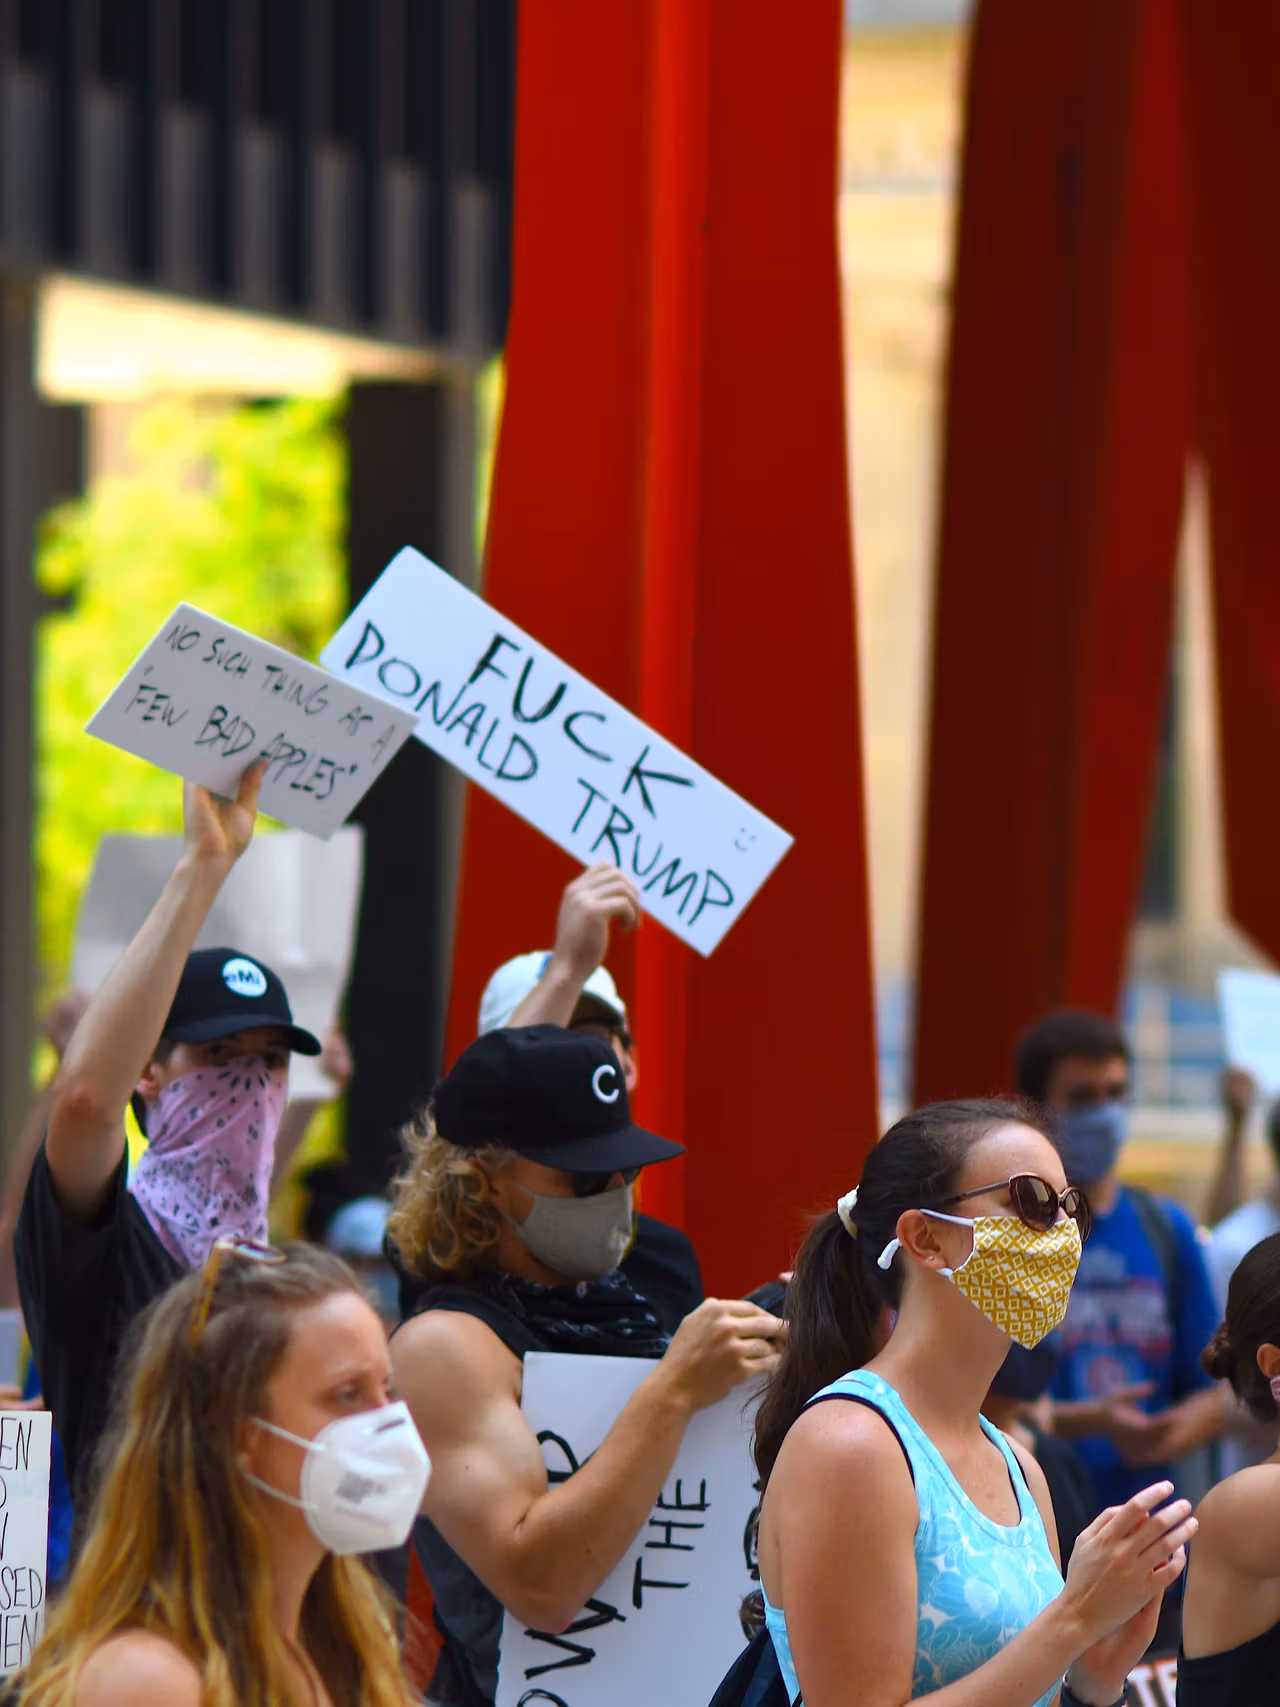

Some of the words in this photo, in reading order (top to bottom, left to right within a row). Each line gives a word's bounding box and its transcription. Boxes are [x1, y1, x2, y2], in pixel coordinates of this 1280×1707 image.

[164, 623, 200, 652] NO
[202, 637, 252, 680] SUCH
[261, 664, 329, 715] THING
[337, 705, 374, 736] AS
[194, 704, 256, 757] BAD
[467, 632, 695, 819] FUCK
[343, 620, 538, 783] DONALD
[571, 777, 736, 928] TRUMP
[592, 1064, 619, 1104] C
[633, 1478, 711, 1609] THE
